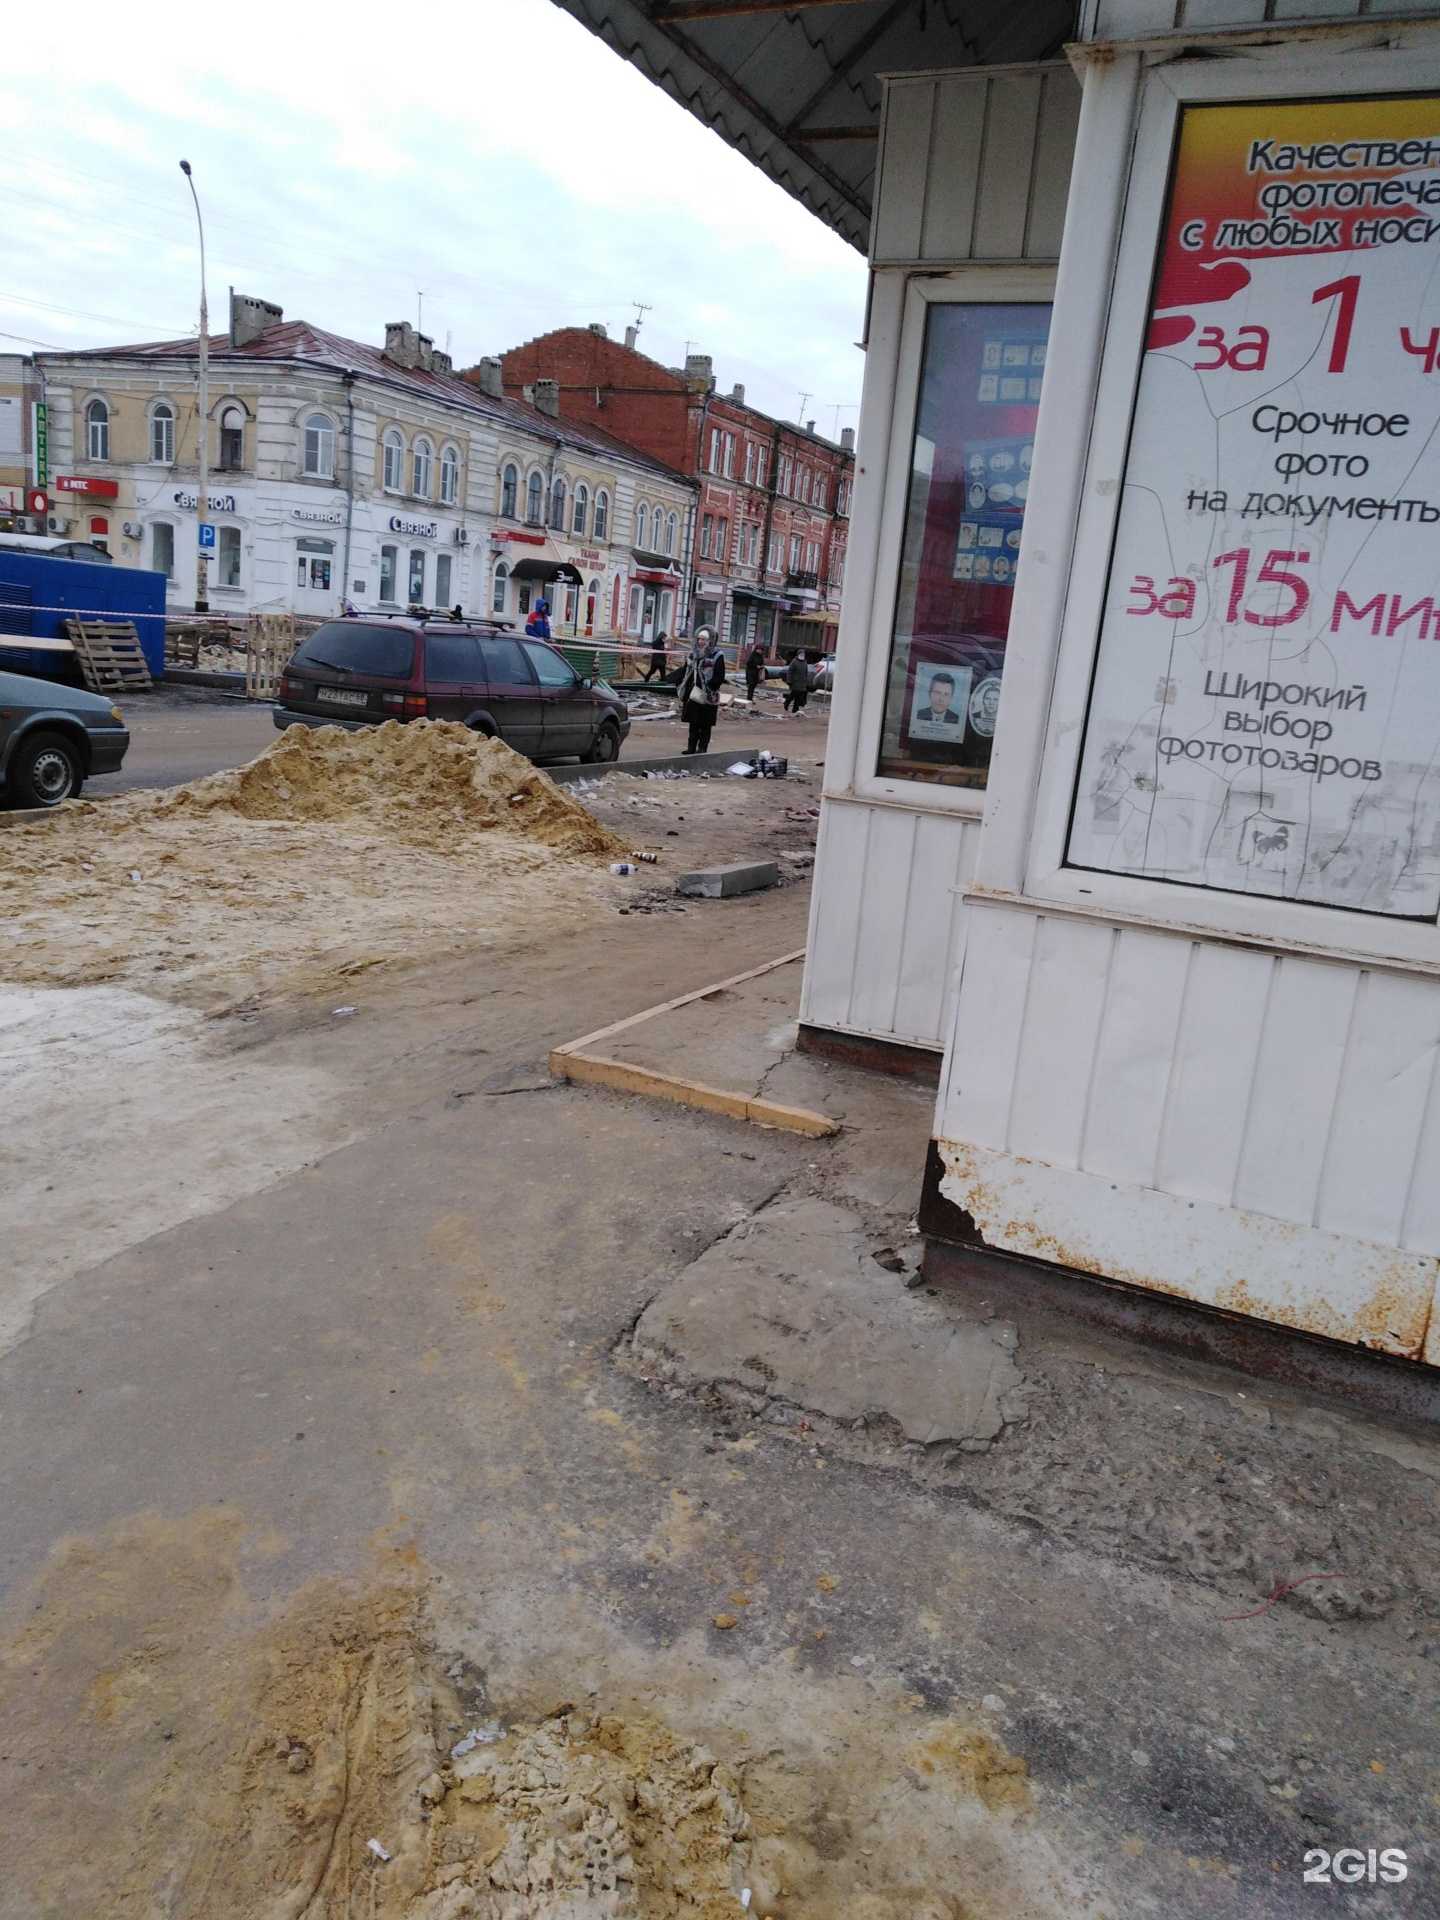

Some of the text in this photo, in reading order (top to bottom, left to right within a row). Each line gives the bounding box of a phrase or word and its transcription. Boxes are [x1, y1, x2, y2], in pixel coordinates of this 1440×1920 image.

[1183, 221, 1204, 247] с
[1215, 217, 1339, 246] любых
[1194, 275, 1440, 373] за 1 ч
[1252, 405, 1409, 443] Срочное
[1275, 452, 1369, 484] фото
[1187, 490, 1228, 512] на
[1126, 575, 1197, 619] за
[1212, 547, 1310, 627] 15
[1203, 670, 1367, 712] Широкий
[1223, 710, 1333, 748] выбор
